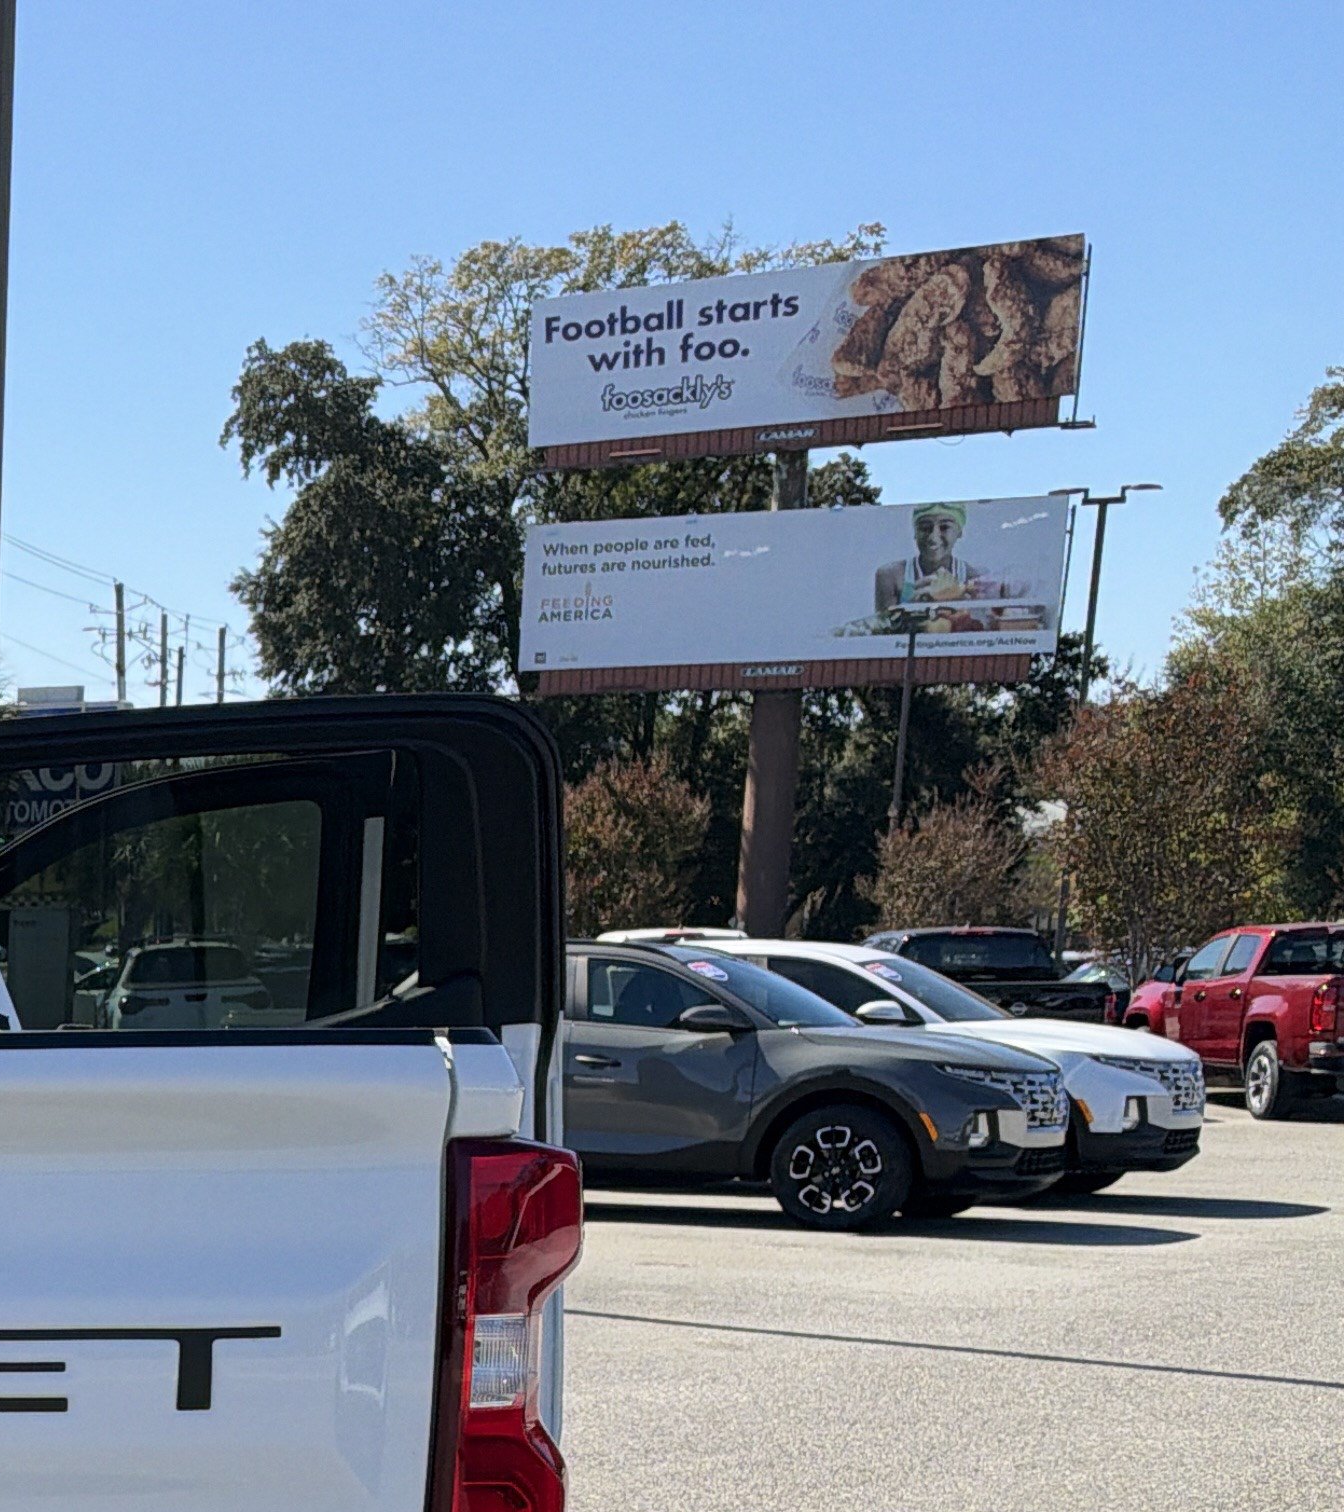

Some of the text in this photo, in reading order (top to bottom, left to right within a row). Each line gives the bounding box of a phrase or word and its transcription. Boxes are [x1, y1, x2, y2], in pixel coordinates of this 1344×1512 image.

[545, 299, 684, 343] Football
[698, 293, 799, 326] starts
[588, 333, 751, 372] with foo.
[601, 374, 732, 412] foosackly's
[543, 533, 716, 557] When people are fed,
[542, 553, 715, 576] futures are nourished.
[541, 594, 613, 610] FEEDING
[538, 608, 613, 623] AMERICA
[895, 637, 1036, 649] FeingAmerica.org/ActNow
